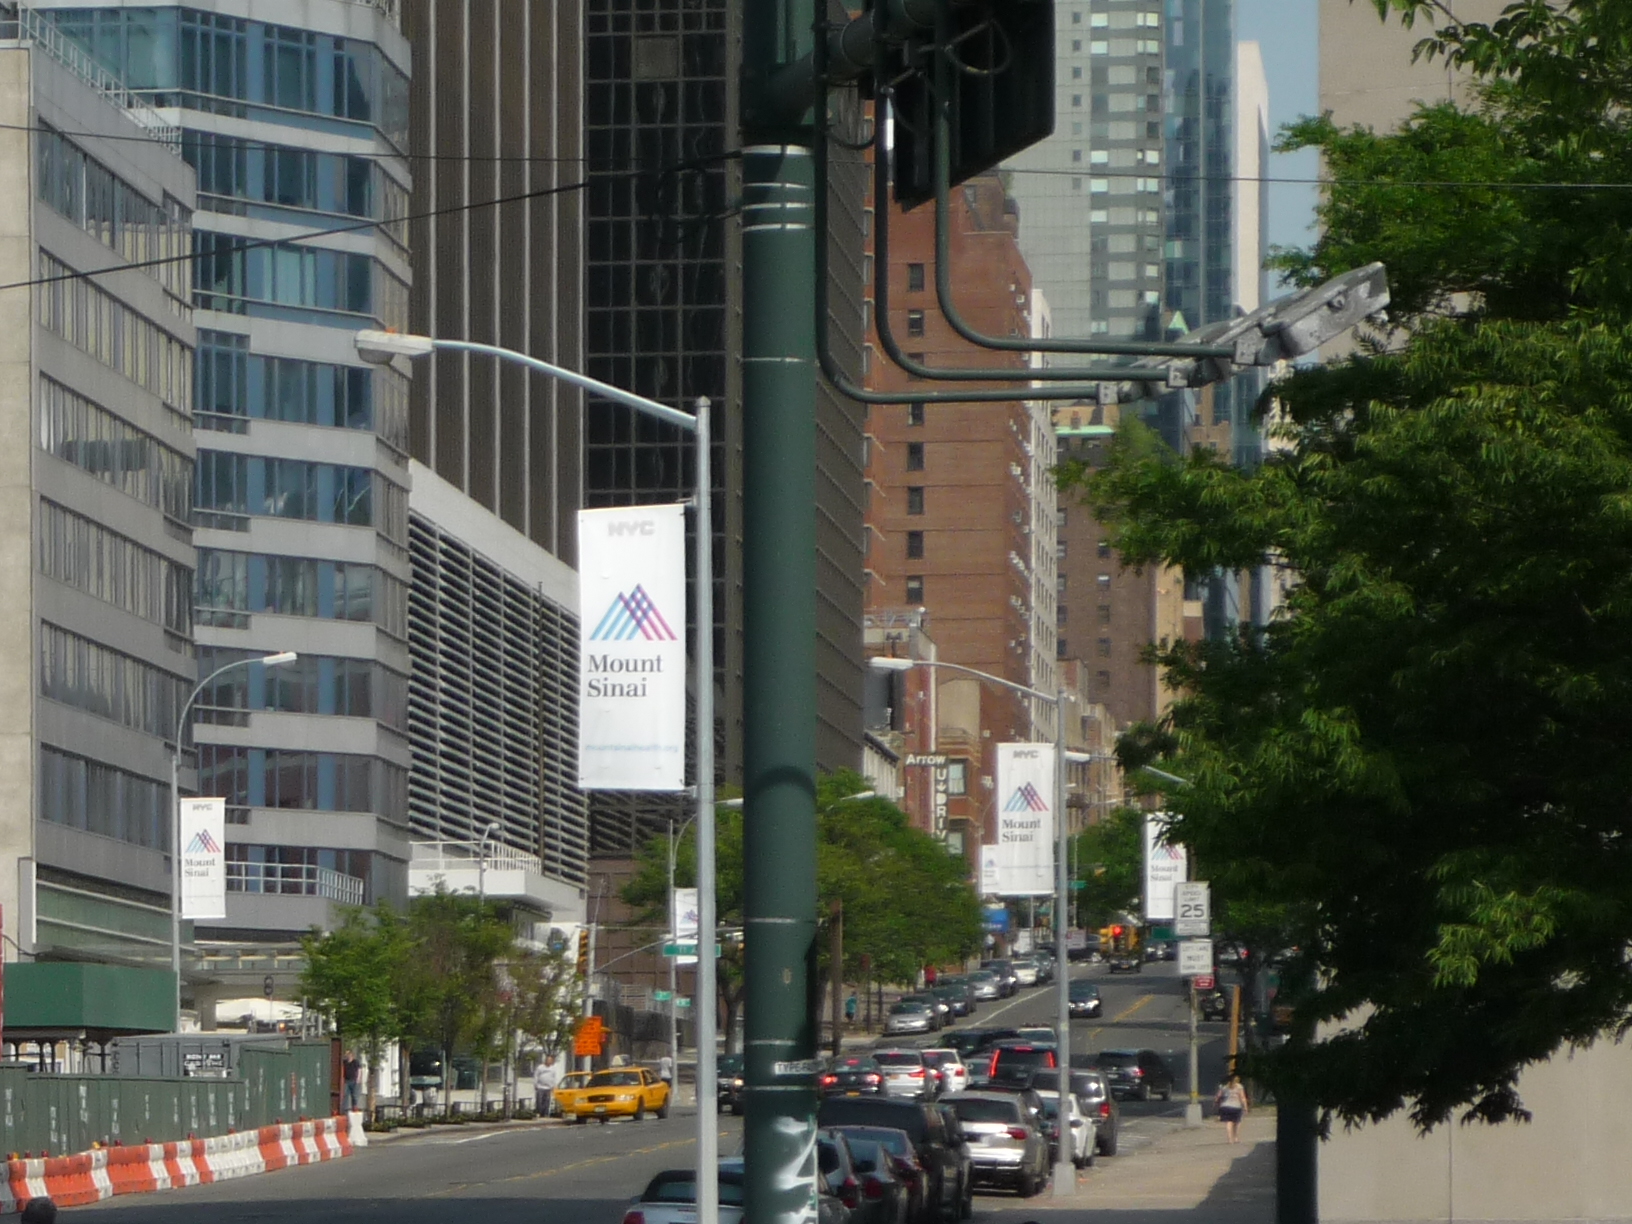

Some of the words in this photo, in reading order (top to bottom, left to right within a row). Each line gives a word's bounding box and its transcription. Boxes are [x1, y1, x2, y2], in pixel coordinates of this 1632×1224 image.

[607, 520, 656, 537] NYC
[587, 653, 665, 674] Mount
[586, 677, 648, 698] Sinai
[905, 753, 947, 766] Arrow
[1012, 749, 1039, 759] NYC
[1001, 818, 1042, 830] Mount
[1001, 830, 1034, 842] Sinai
[184, 857, 216, 867] Mount
[184, 867, 209, 877] Sinai
[1150, 864, 1179, 873] Mount
[1150, 873, 1173, 882] Sinai
[1179, 904, 1205, 918] 25
